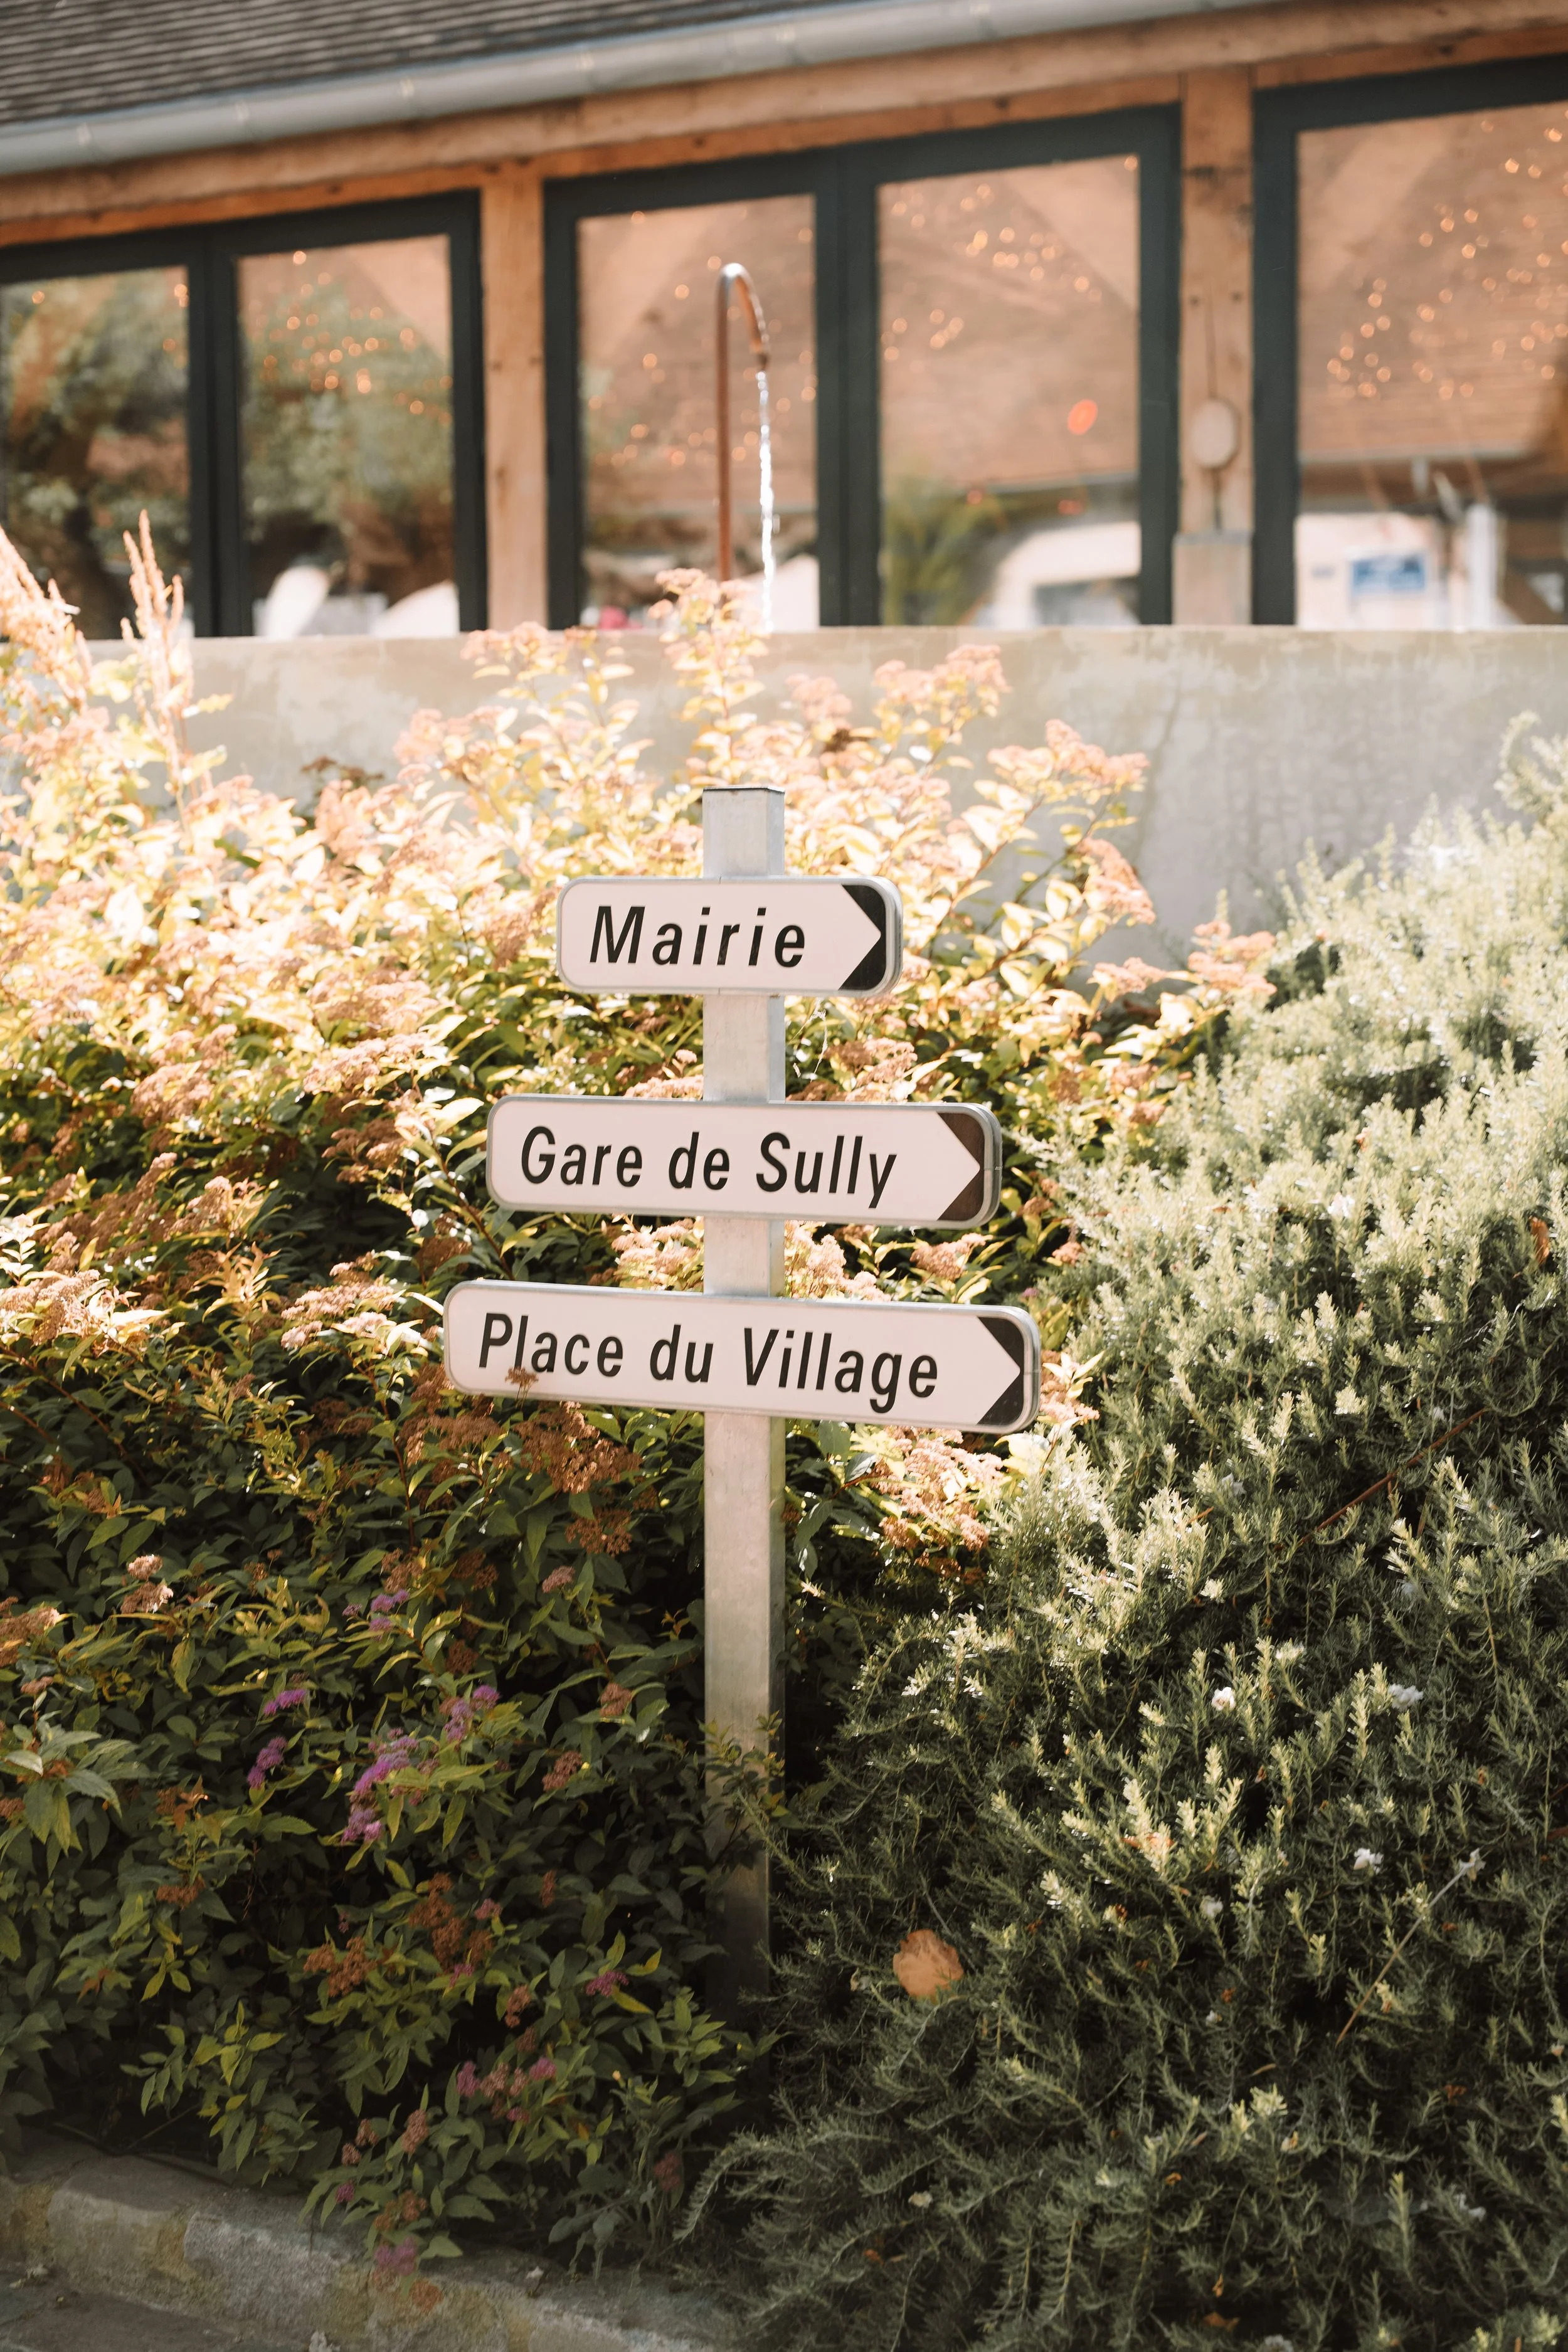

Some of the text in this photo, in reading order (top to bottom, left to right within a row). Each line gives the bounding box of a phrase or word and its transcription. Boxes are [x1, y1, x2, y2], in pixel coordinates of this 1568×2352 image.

[590, 906, 805, 968] Mairie
[521, 1126, 897, 1209] Gare de Sully
[479, 1312, 938, 1414] Place du Village
